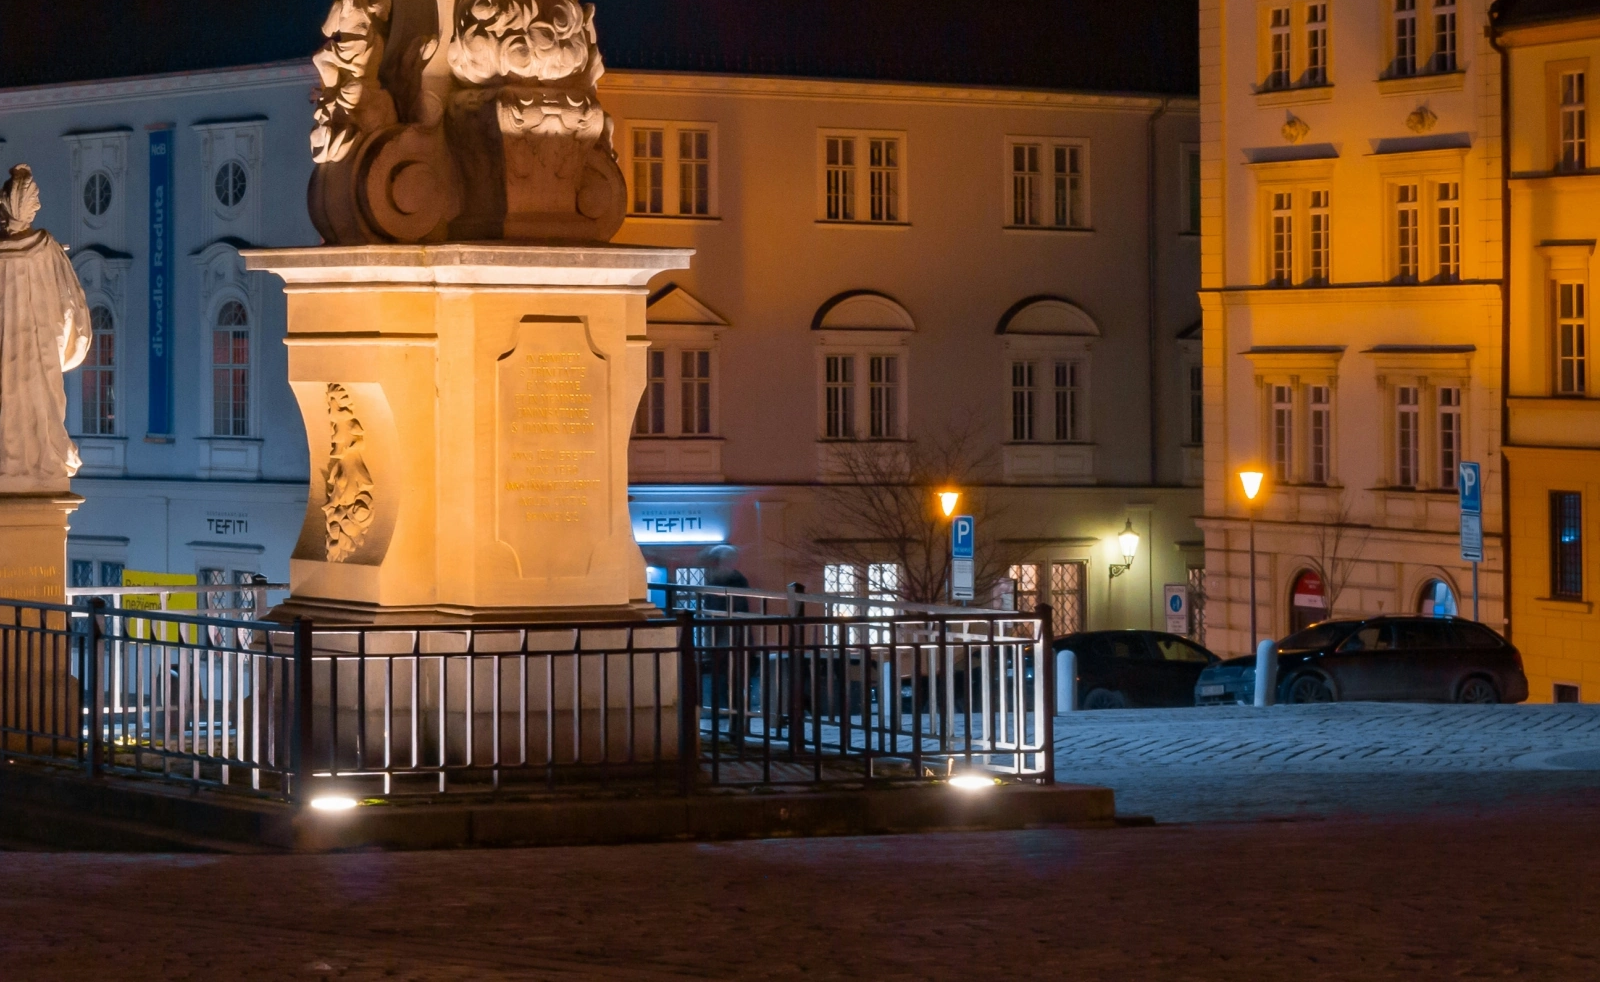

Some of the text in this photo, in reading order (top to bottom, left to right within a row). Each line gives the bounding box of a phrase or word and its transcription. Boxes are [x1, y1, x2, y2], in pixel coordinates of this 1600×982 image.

[151, 143, 167, 154] NdB
[152, 185, 164, 357] divadlo Reduta
[1463, 466, 1476, 496] P
[206, 518, 248, 535] TEFITI
[642, 517, 702, 533] TEFITI
[957, 520, 970, 544] P
